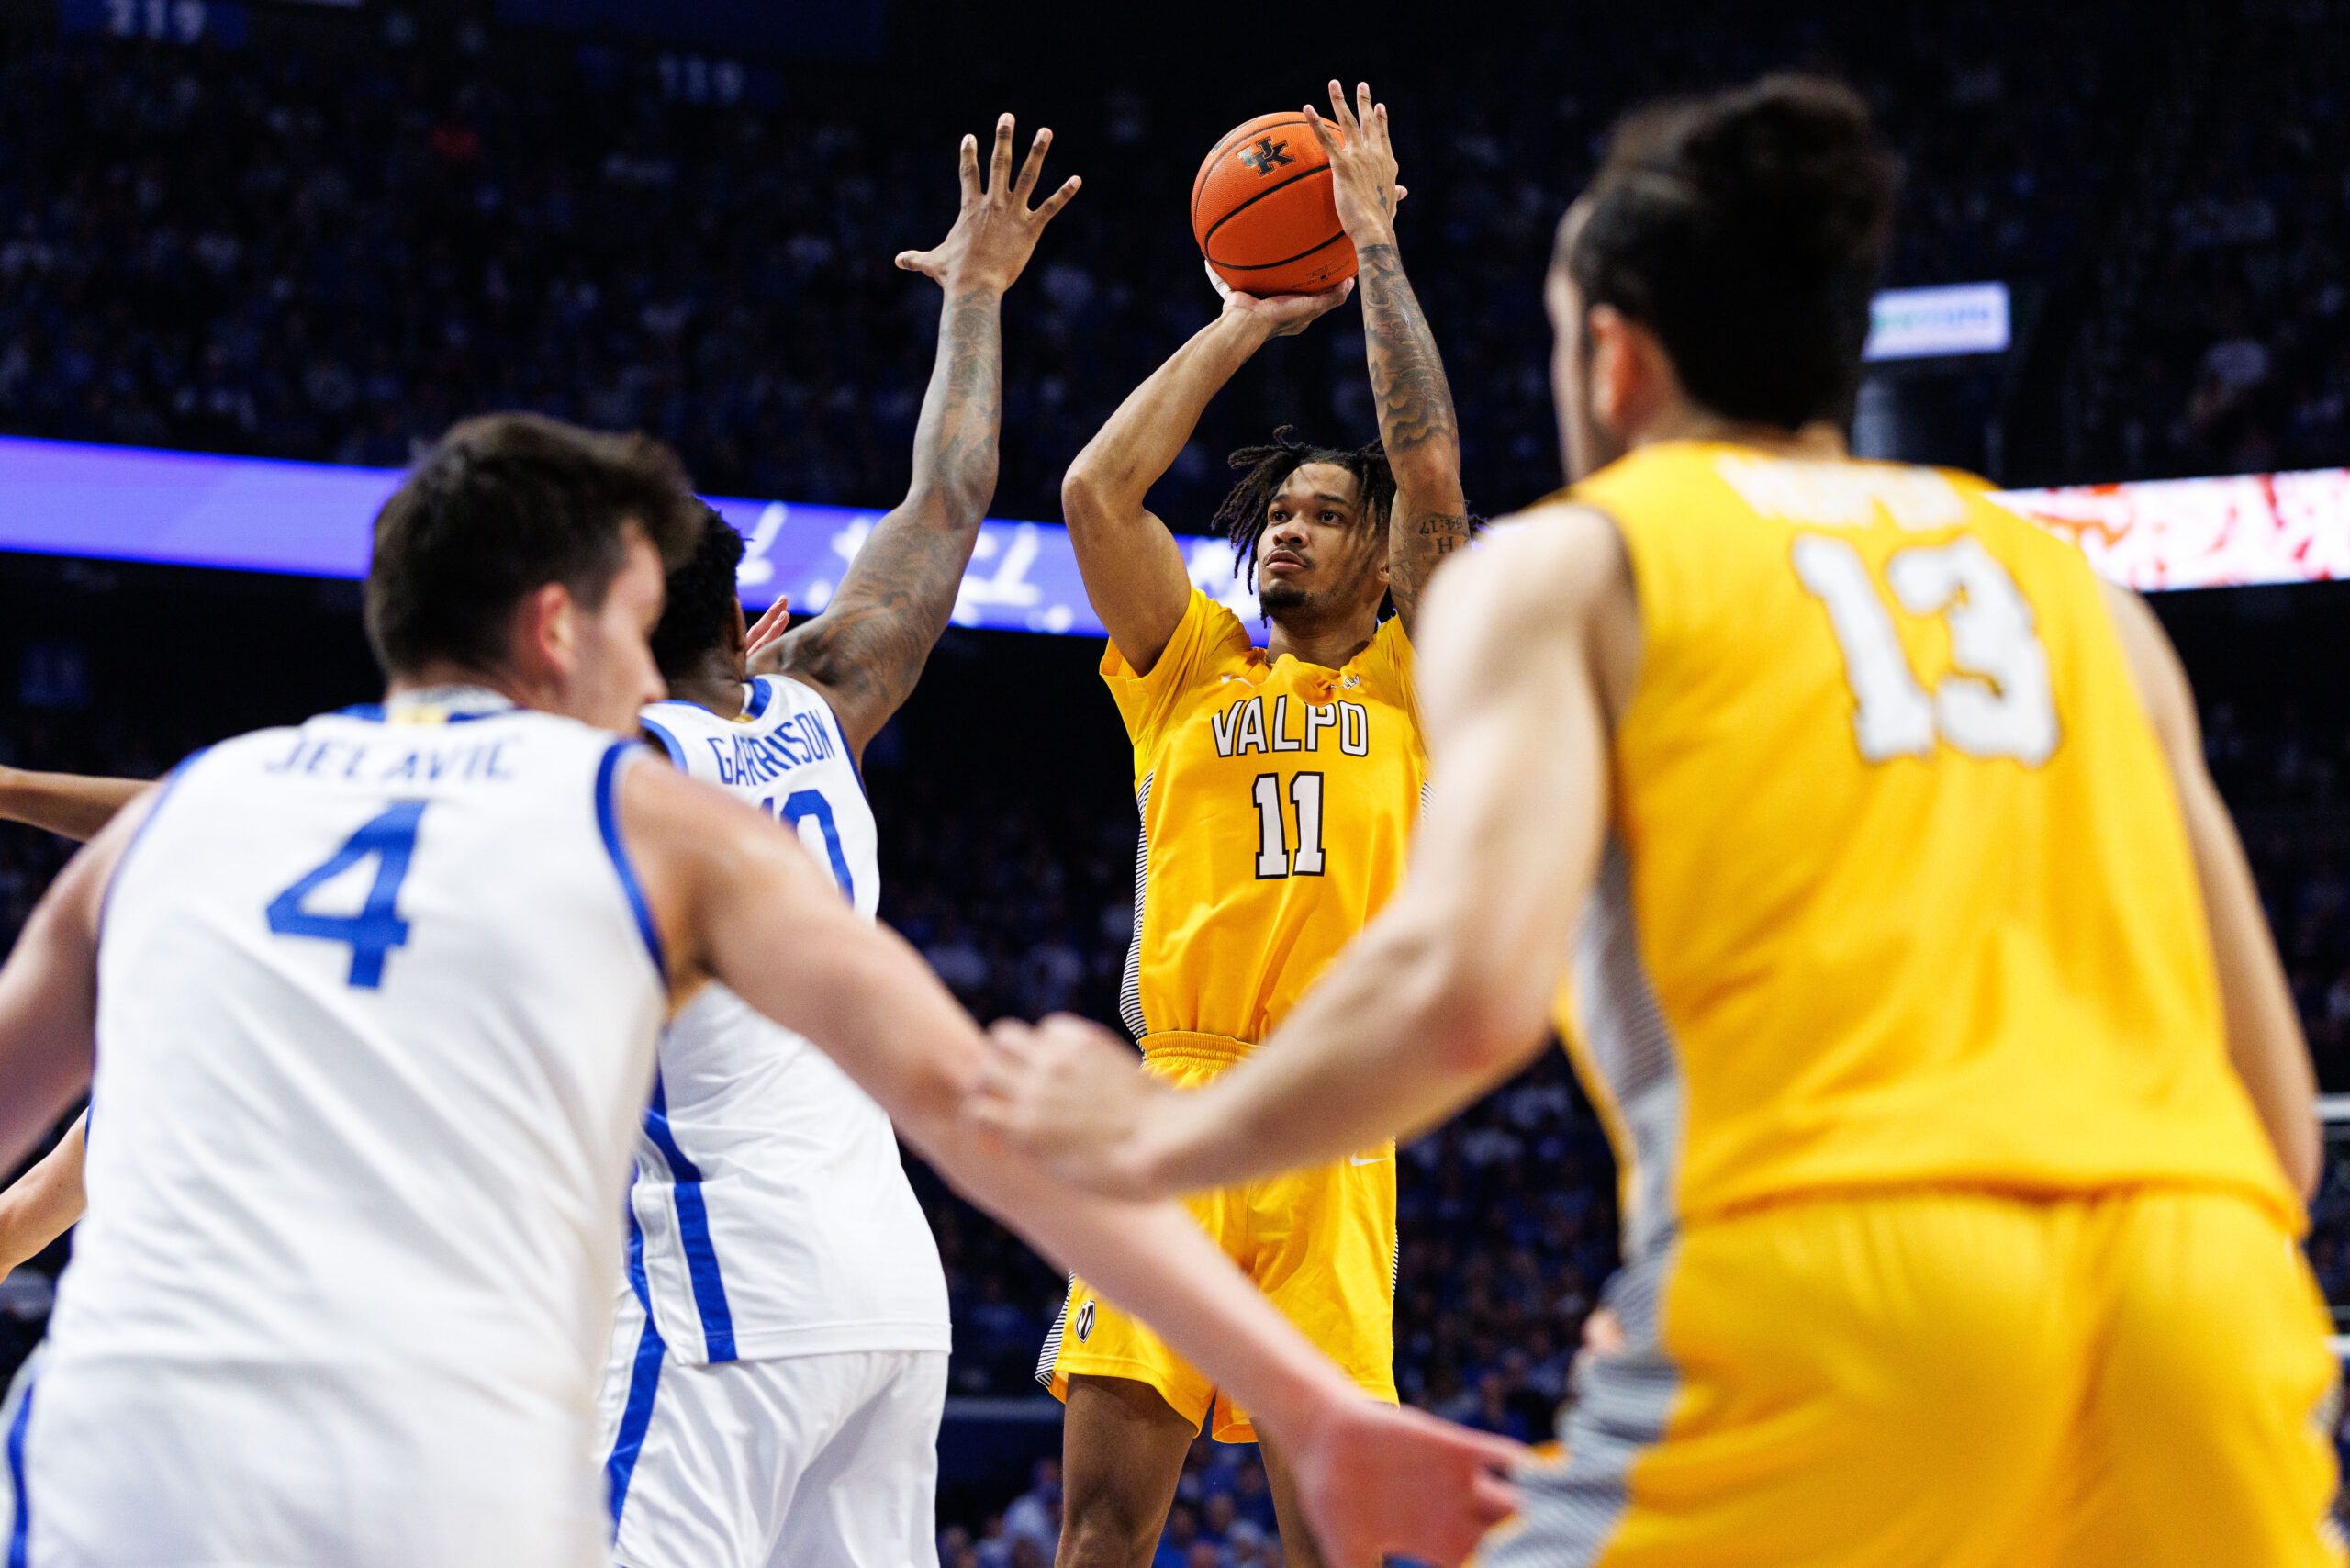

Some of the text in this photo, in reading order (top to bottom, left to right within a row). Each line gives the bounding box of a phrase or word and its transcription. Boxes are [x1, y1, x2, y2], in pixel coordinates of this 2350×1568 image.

[1791, 532, 2061, 769] 13
[706, 709, 836, 787] GARRISON
[1212, 694, 1369, 757] VALPO
[759, 790, 856, 911] 0
[1251, 771, 1326, 879] 11
[265, 797, 428, 991] 4
